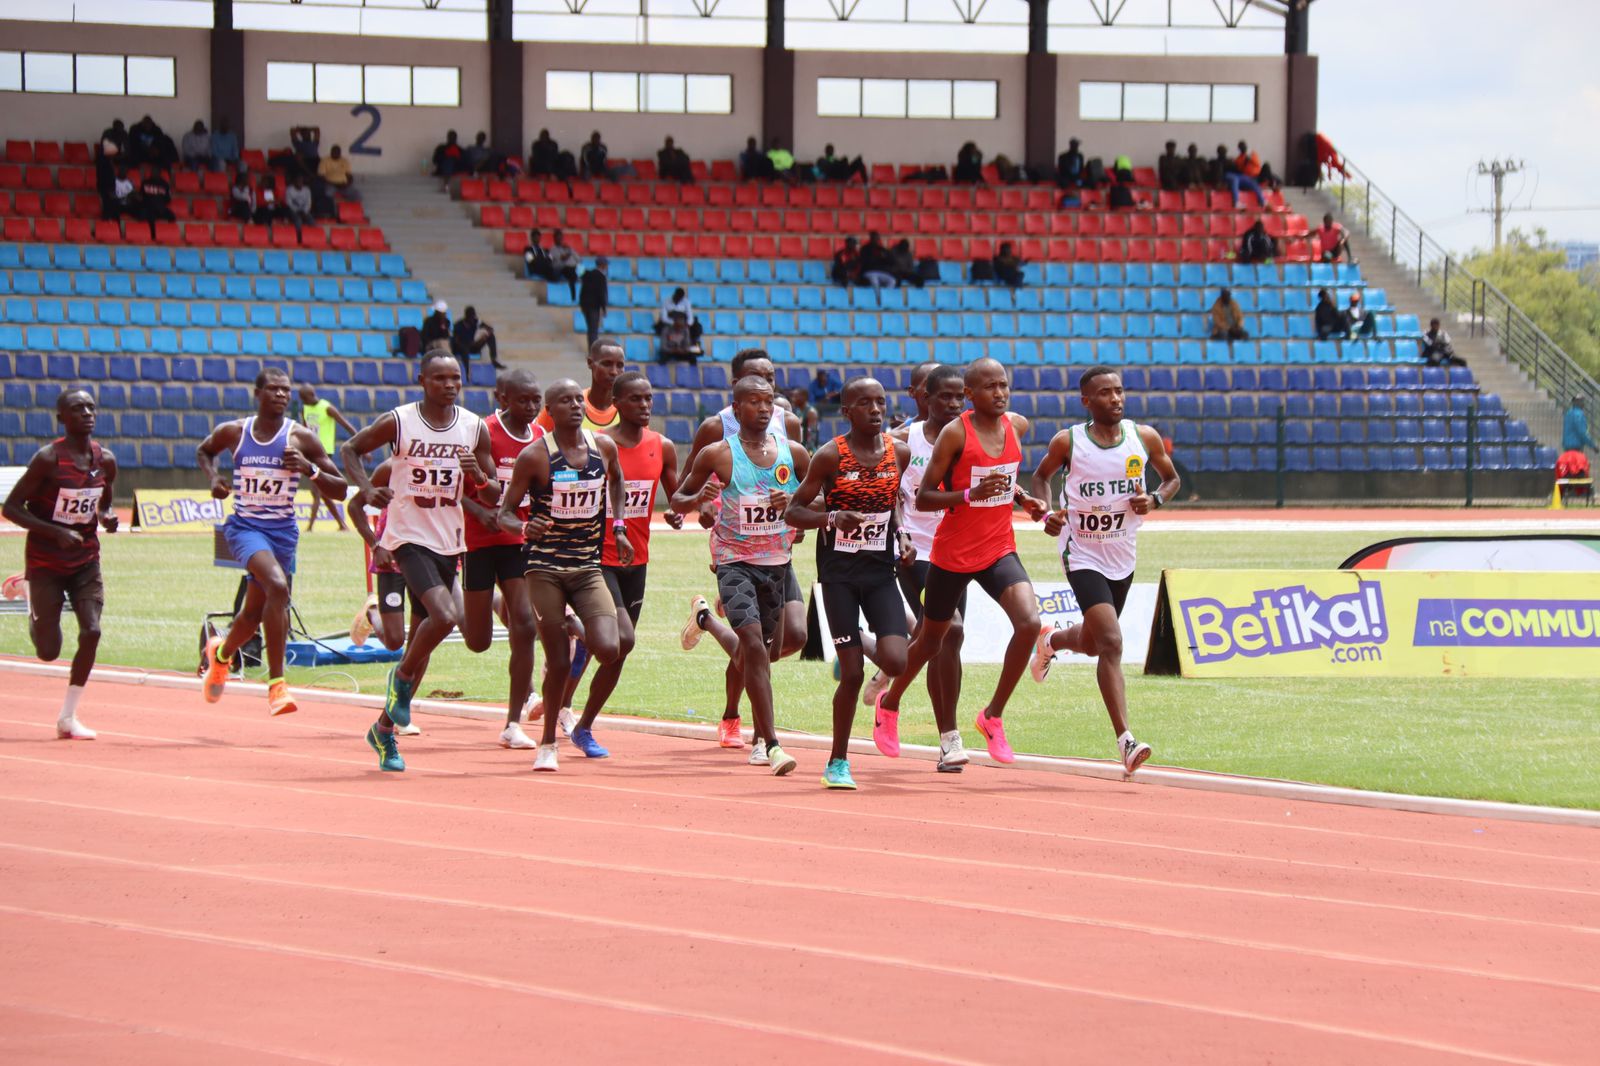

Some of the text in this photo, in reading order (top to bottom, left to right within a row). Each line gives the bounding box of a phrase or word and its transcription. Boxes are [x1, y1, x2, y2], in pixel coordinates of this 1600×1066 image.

[349, 104, 382, 156] 2
[412, 468, 453, 486] 913
[245, 478, 283, 495] 1147
[1080, 481, 1105, 497] KFS
[62, 498, 97, 514] 1266
[561, 491, 597, 508] 1171
[624, 490, 649, 506] 272
[1079, 513, 1125, 531] 1097
[1035, 590, 1080, 613] etik
[1187, 587, 1383, 657] Betika!
[1429, 620, 1458, 637] na
[1331, 645, 1382, 664] .com
